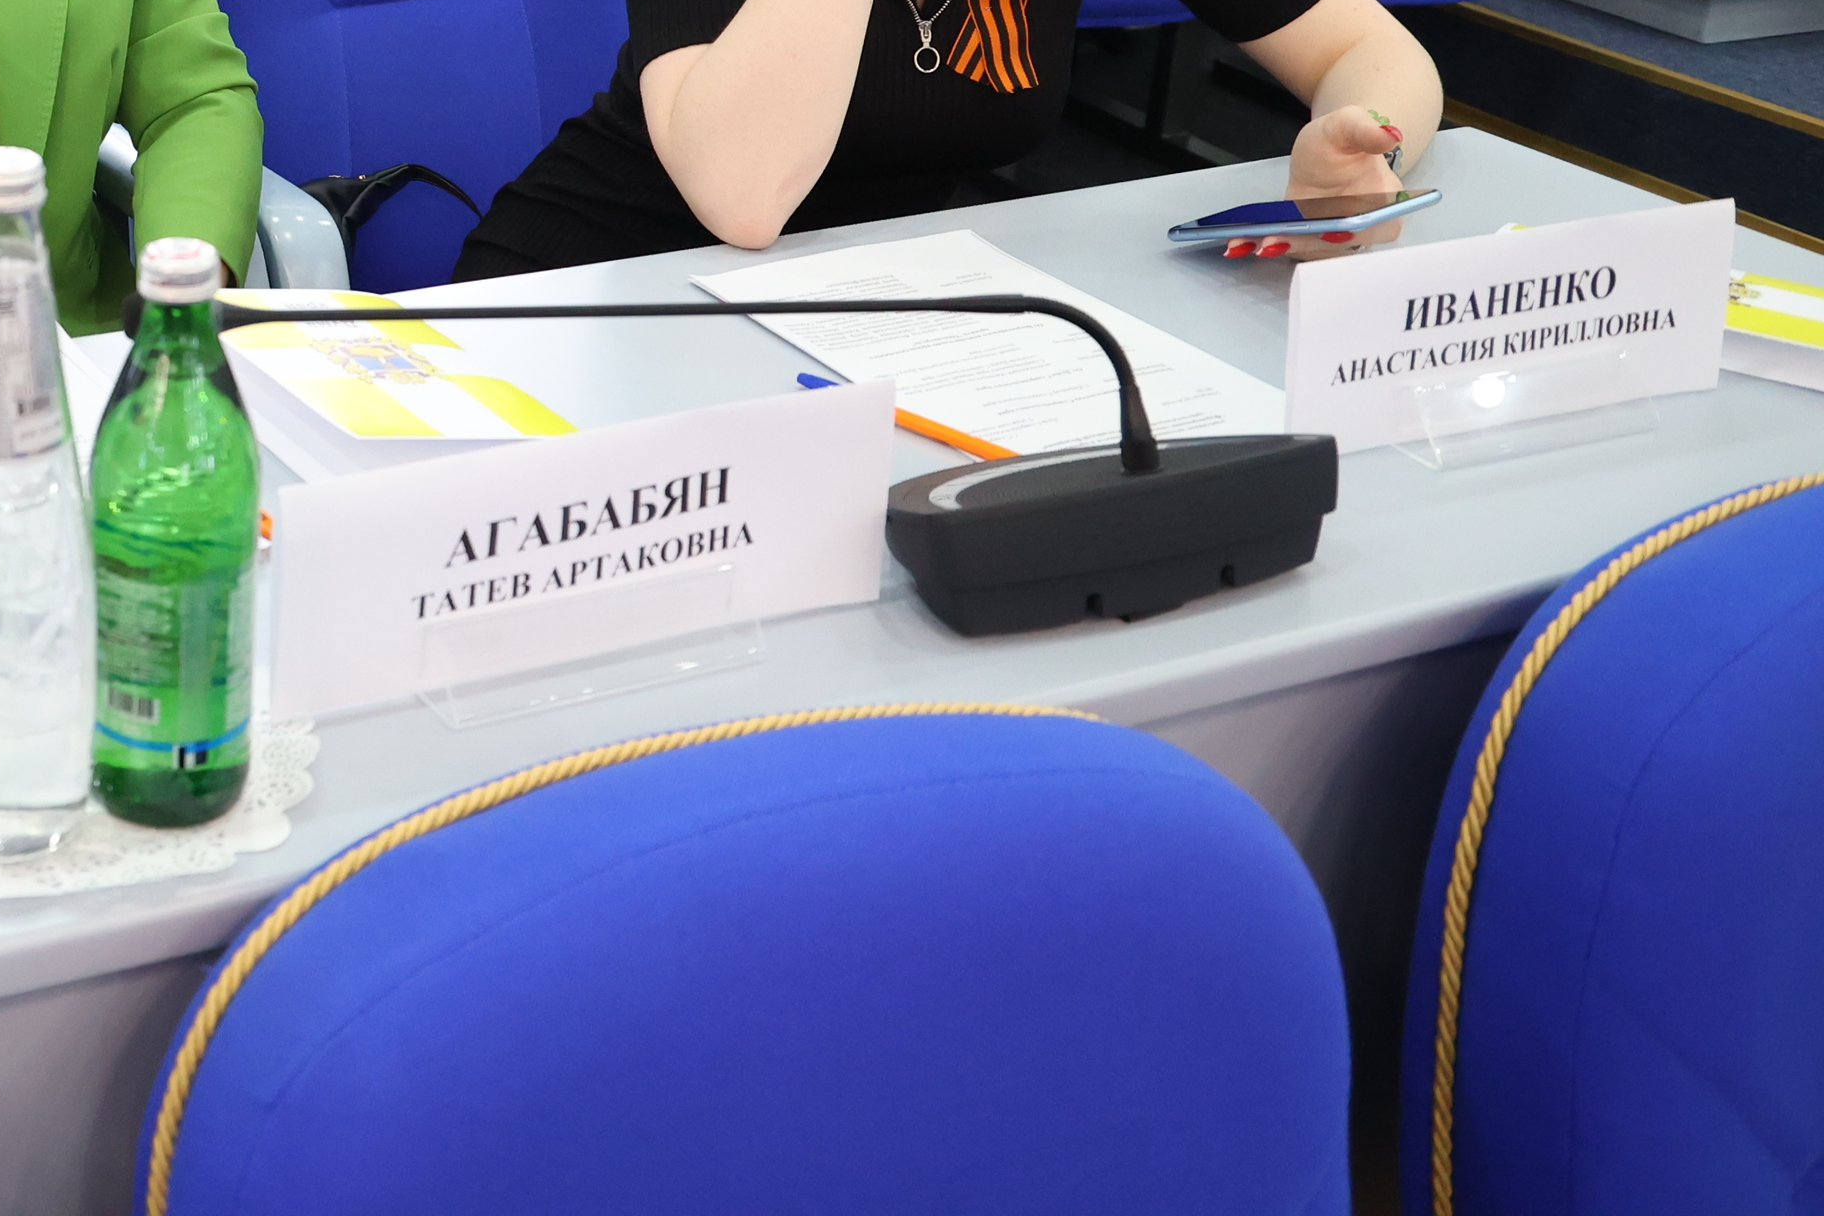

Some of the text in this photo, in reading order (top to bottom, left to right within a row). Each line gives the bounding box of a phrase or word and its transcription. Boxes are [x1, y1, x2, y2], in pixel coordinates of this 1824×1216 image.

[1402, 265, 1617, 332] ИВАНЕНКО
[1330, 307, 1677, 386] АНАСТАСИЯ КИРИЛЛОВНА
[444, 466, 732, 569] АГАБАБЯН
[410, 521, 754, 620] ТАТЕВ АРТАКОВНА
